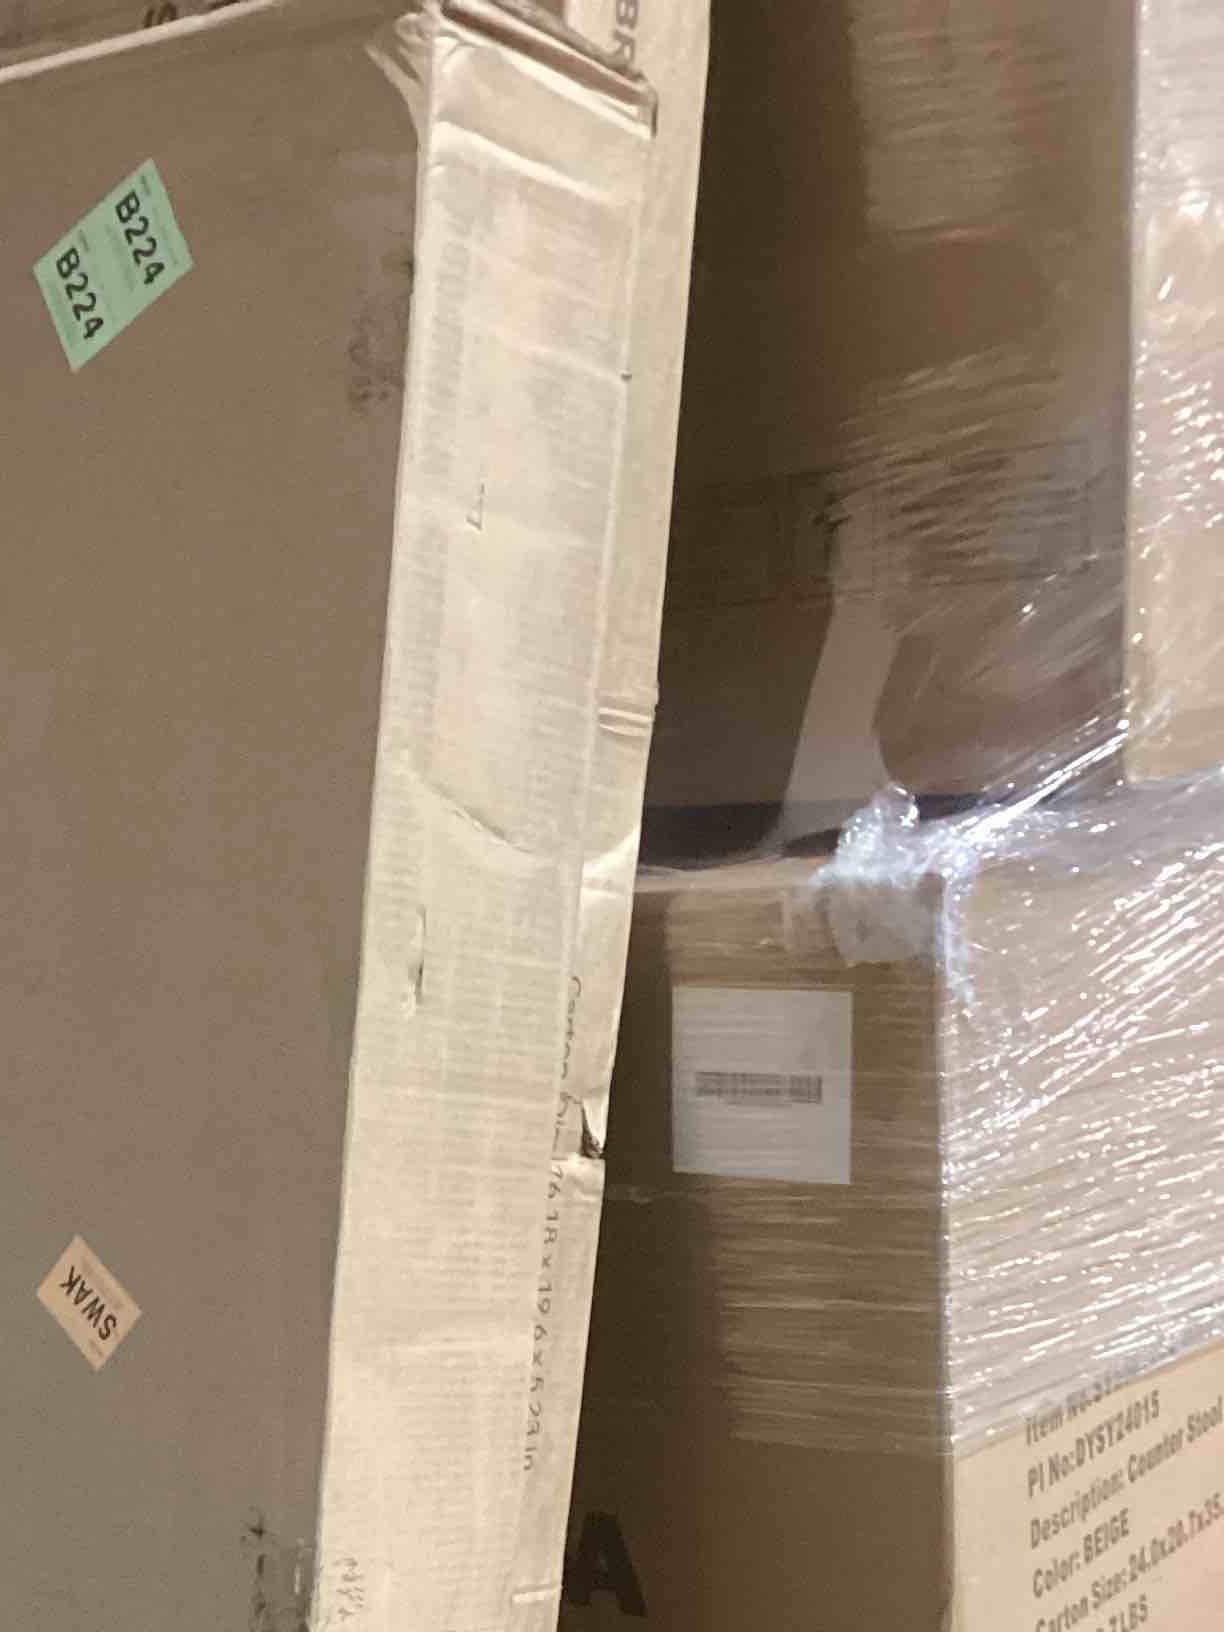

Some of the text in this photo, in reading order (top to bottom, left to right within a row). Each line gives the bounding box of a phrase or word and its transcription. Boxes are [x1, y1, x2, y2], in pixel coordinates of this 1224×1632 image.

[115, 190, 165, 285] B224
[56, 248, 104, 339] B224
[58, 1265, 117, 1341] SWAK
[1030, 1468, 1125, 1550] Description:
[1127, 1427, 1184, 1484] Counter
[1033, 1507, 1130, 1600] Color: BEIGE
